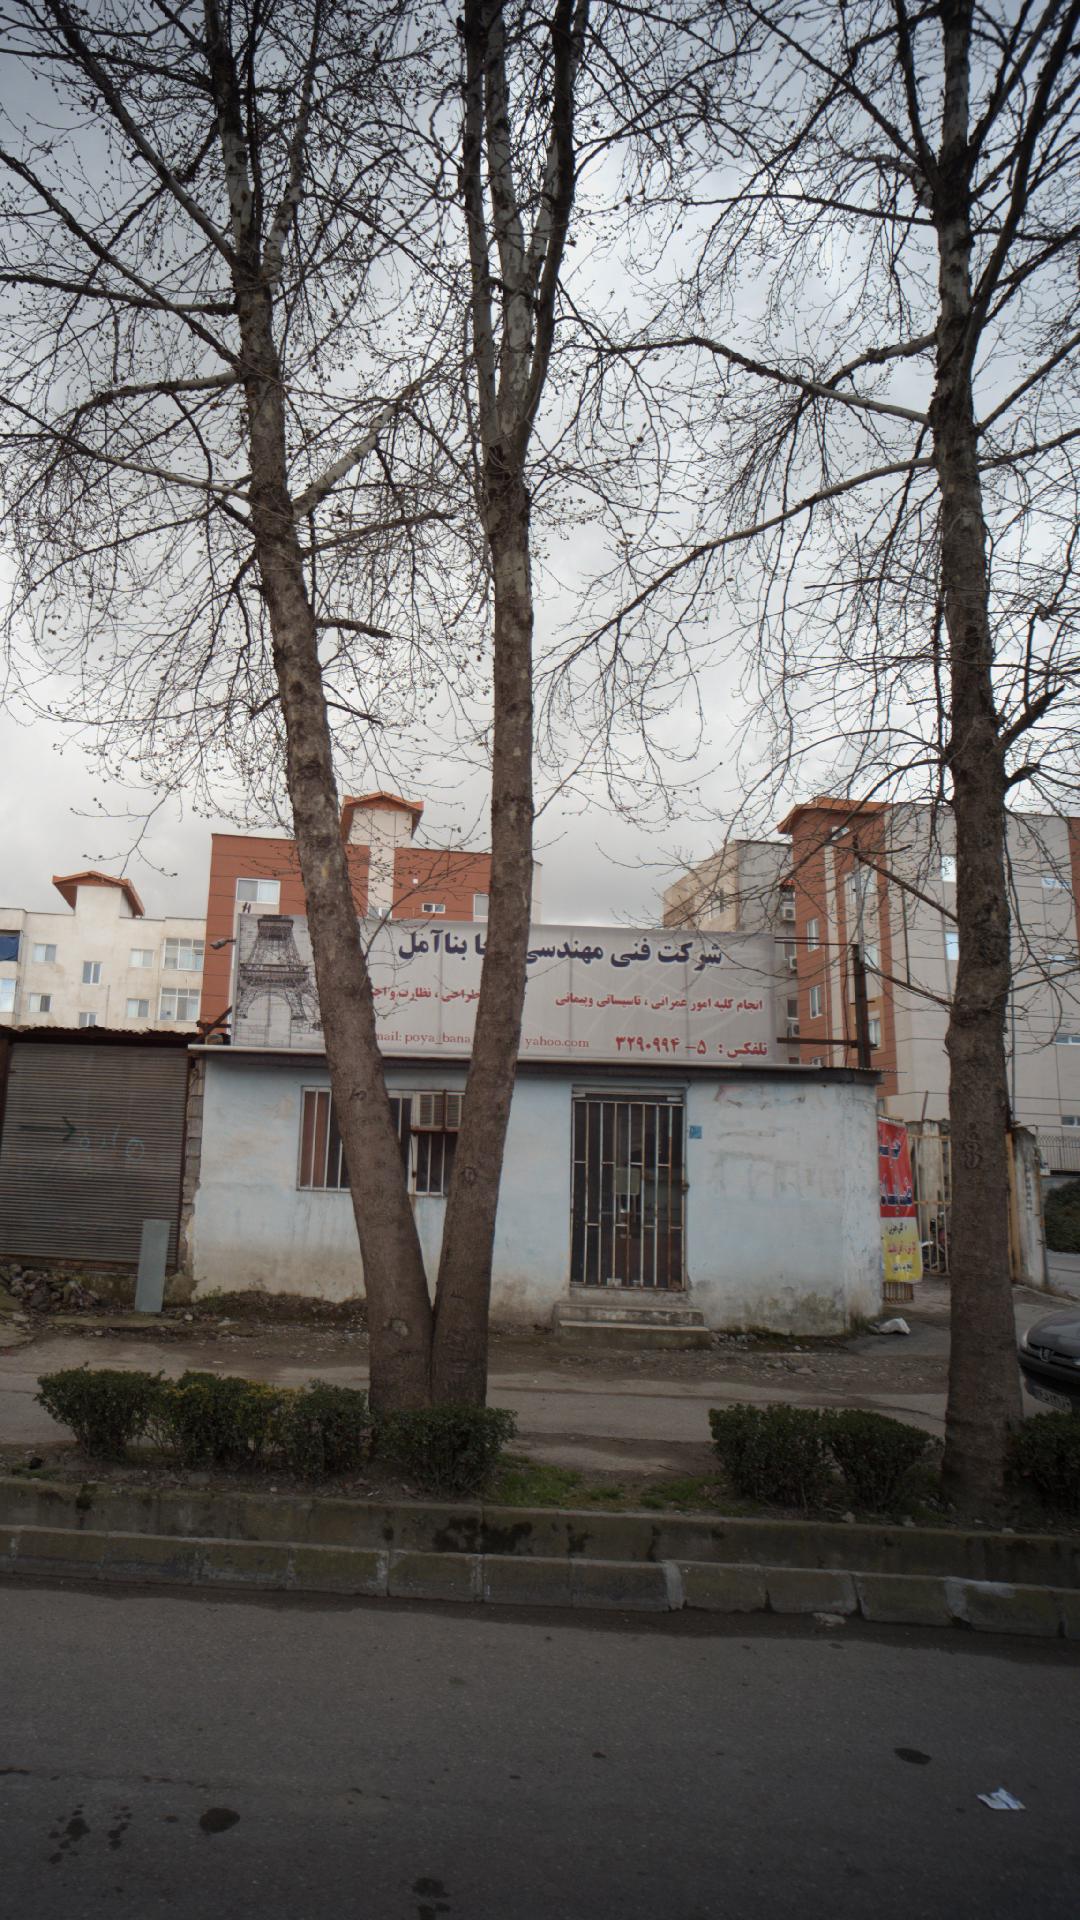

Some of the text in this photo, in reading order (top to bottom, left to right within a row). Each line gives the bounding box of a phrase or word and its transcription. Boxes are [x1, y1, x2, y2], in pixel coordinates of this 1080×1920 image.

[398, 929, 444, 960] آمل
[445, 932, 468, 961] بنا
[526, 937, 722, 971] شرکت فنی مهندسی
[651, 995, 688, 1011] عمرانی
[689, 997, 712, 1012] امور
[713, 998, 734, 1012] کلیه
[737, 998, 763, 1012] انجام
